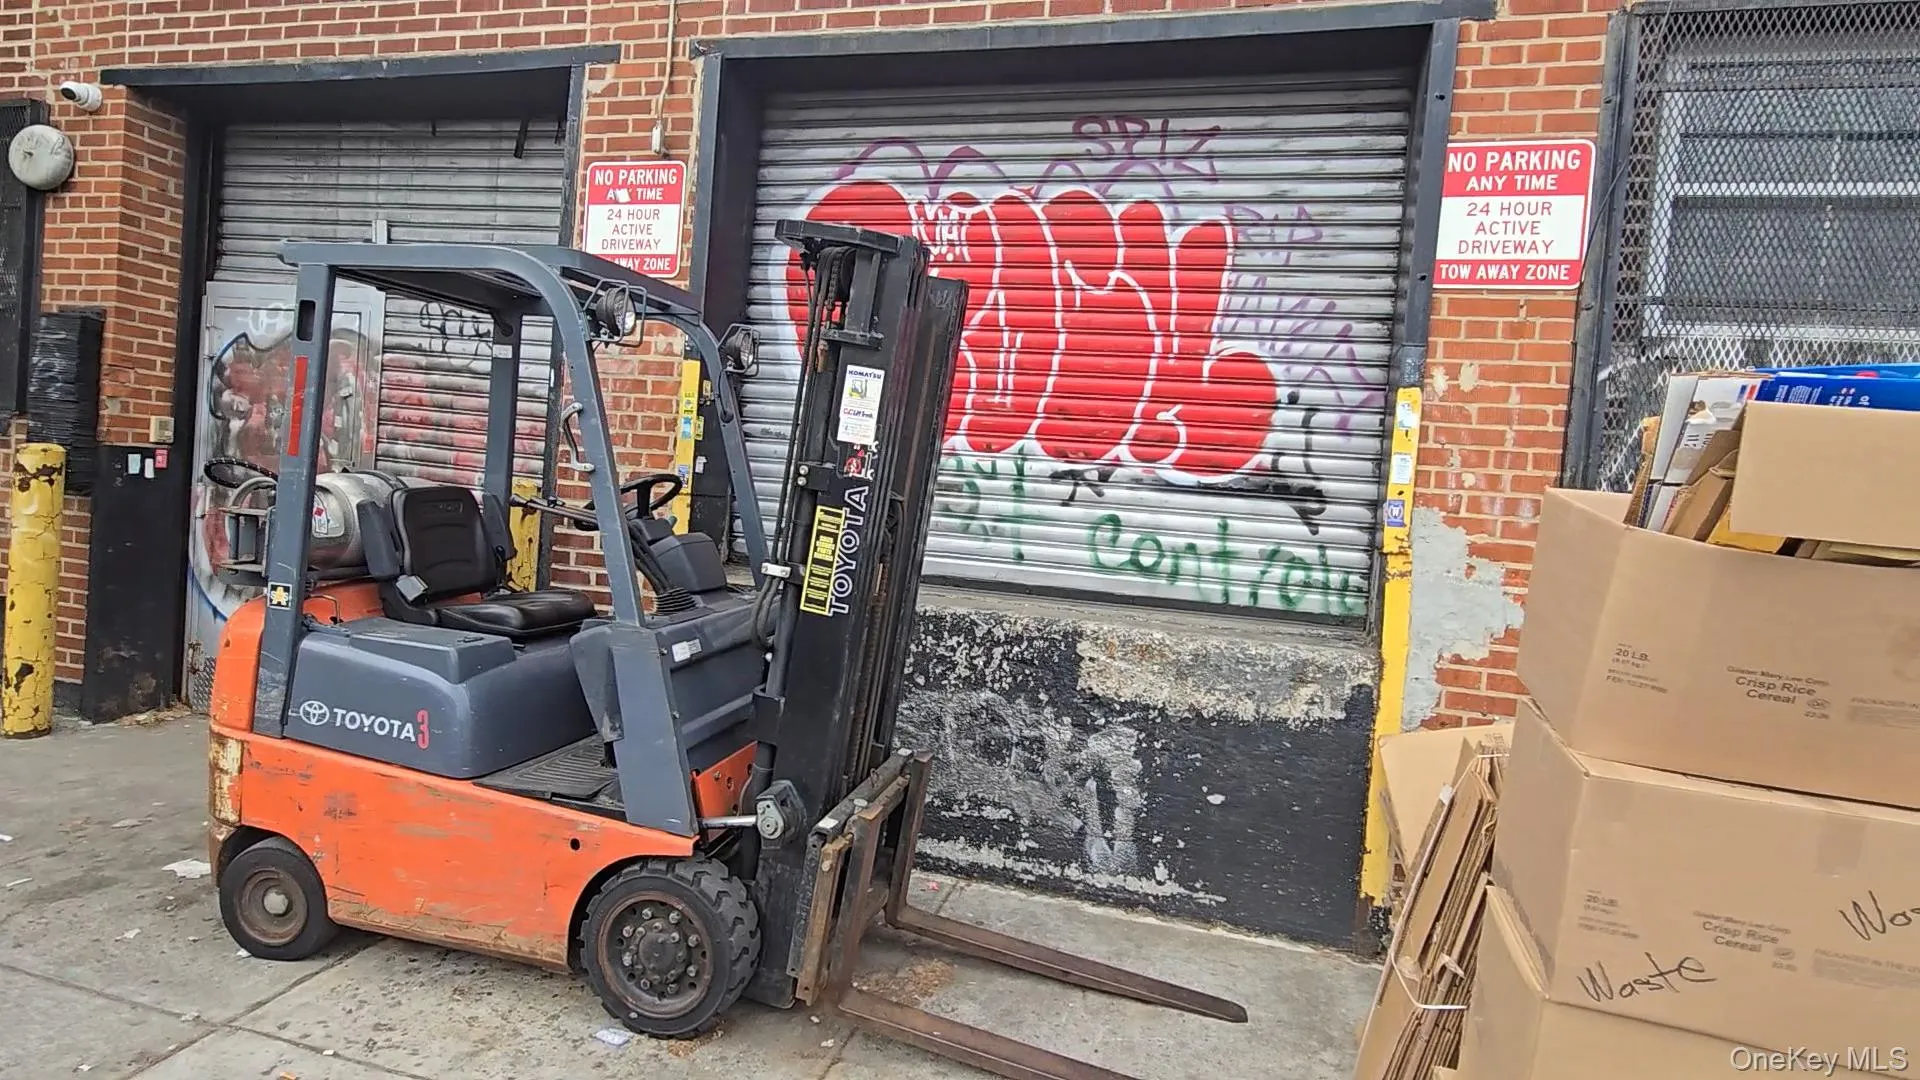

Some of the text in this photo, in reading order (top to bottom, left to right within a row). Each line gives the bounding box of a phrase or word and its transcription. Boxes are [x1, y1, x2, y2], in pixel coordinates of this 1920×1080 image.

[1447, 149, 1581, 173] NO PARKING
[594, 168, 678, 185] NO PARKING
[1465, 174, 1559, 191] ANY TIME
[636, 187, 665, 201] TIME
[607, 208, 660, 221] 24 HOUR
[1466, 201, 1553, 216] 24 HOUR
[611, 223, 654, 236] ACTIVE
[1475, 220, 1541, 236] ACTIVE
[601, 238, 662, 251] DRIVEWAY
[1458, 239, 1555, 255] DRIVEWAY
[643, 257, 672, 271] ZONE
[1440, 263, 1571, 280] TOW AWAY ZONE
[848, 369, 882, 380] KOMATSU
[828, 486, 869, 617] TOYOTA
[1615, 648, 1630, 657] 20
[1736, 676, 1817, 697] Crisp Rice
[1746, 688, 1797, 705] Cereal
[333, 708, 430, 749] TOYOTA 3
[1703, 920, 1742, 938] Crisp
[1746, 928, 1779, 944] Rice
[1714, 935, 1762, 953] Cereal
[1576, 951, 1718, 1003] Waste
